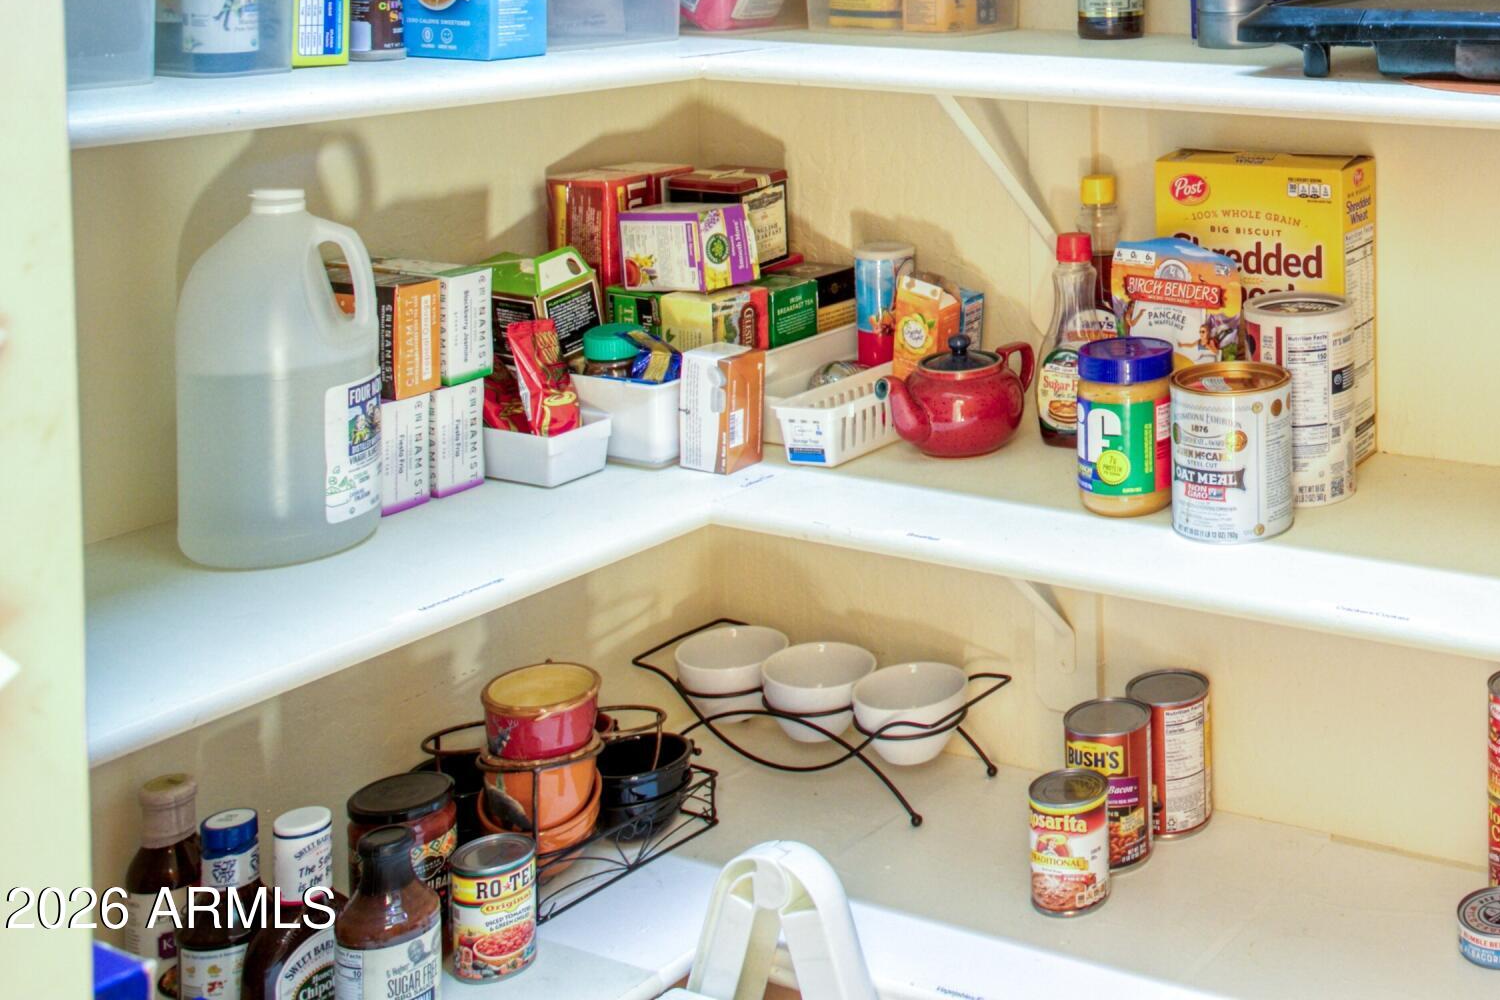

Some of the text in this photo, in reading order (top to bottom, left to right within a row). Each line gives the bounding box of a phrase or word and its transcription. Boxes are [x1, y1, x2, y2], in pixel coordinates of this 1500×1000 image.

[1174, 176, 1205, 197] Post
[1191, 210, 1301, 227] 100% WHOLE GRAIN
[1210, 225, 1282, 237] BIG BISCUIT
[1128, 277, 1219, 304] BIRCH BENDERS
[777, 301, 805, 315] BREAKFAST
[1148, 311, 1187, 325] PANCAKE
[1317, 352, 1327, 360] 150
[1043, 375, 1070, 393] Sugar
[349, 385, 371, 405] FOUR
[1191, 424, 1209, 434] 1876
[1187, 459, 1218, 469] STEEL CUT
[1187, 490, 1208, 499] GMO
[1188, 483, 1207, 491] NON
[1067, 747, 1120, 770] BUSH'S
[1030, 811, 1088, 834] osarita
[293, 843, 316, 860] SWEET
[1031, 853, 1081, 868] RADITIONAL
[298, 864, 316, 878] The
[298, 875, 324, 892] is the
[486, 892, 532, 912] Original
[485, 917, 505, 928] DICED
[495, 919, 513, 930] GREEN
[284, 950, 313, 981] SWEET
[353, 970, 361, 978] 10
[387, 959, 438, 999] SUGAR FREE
